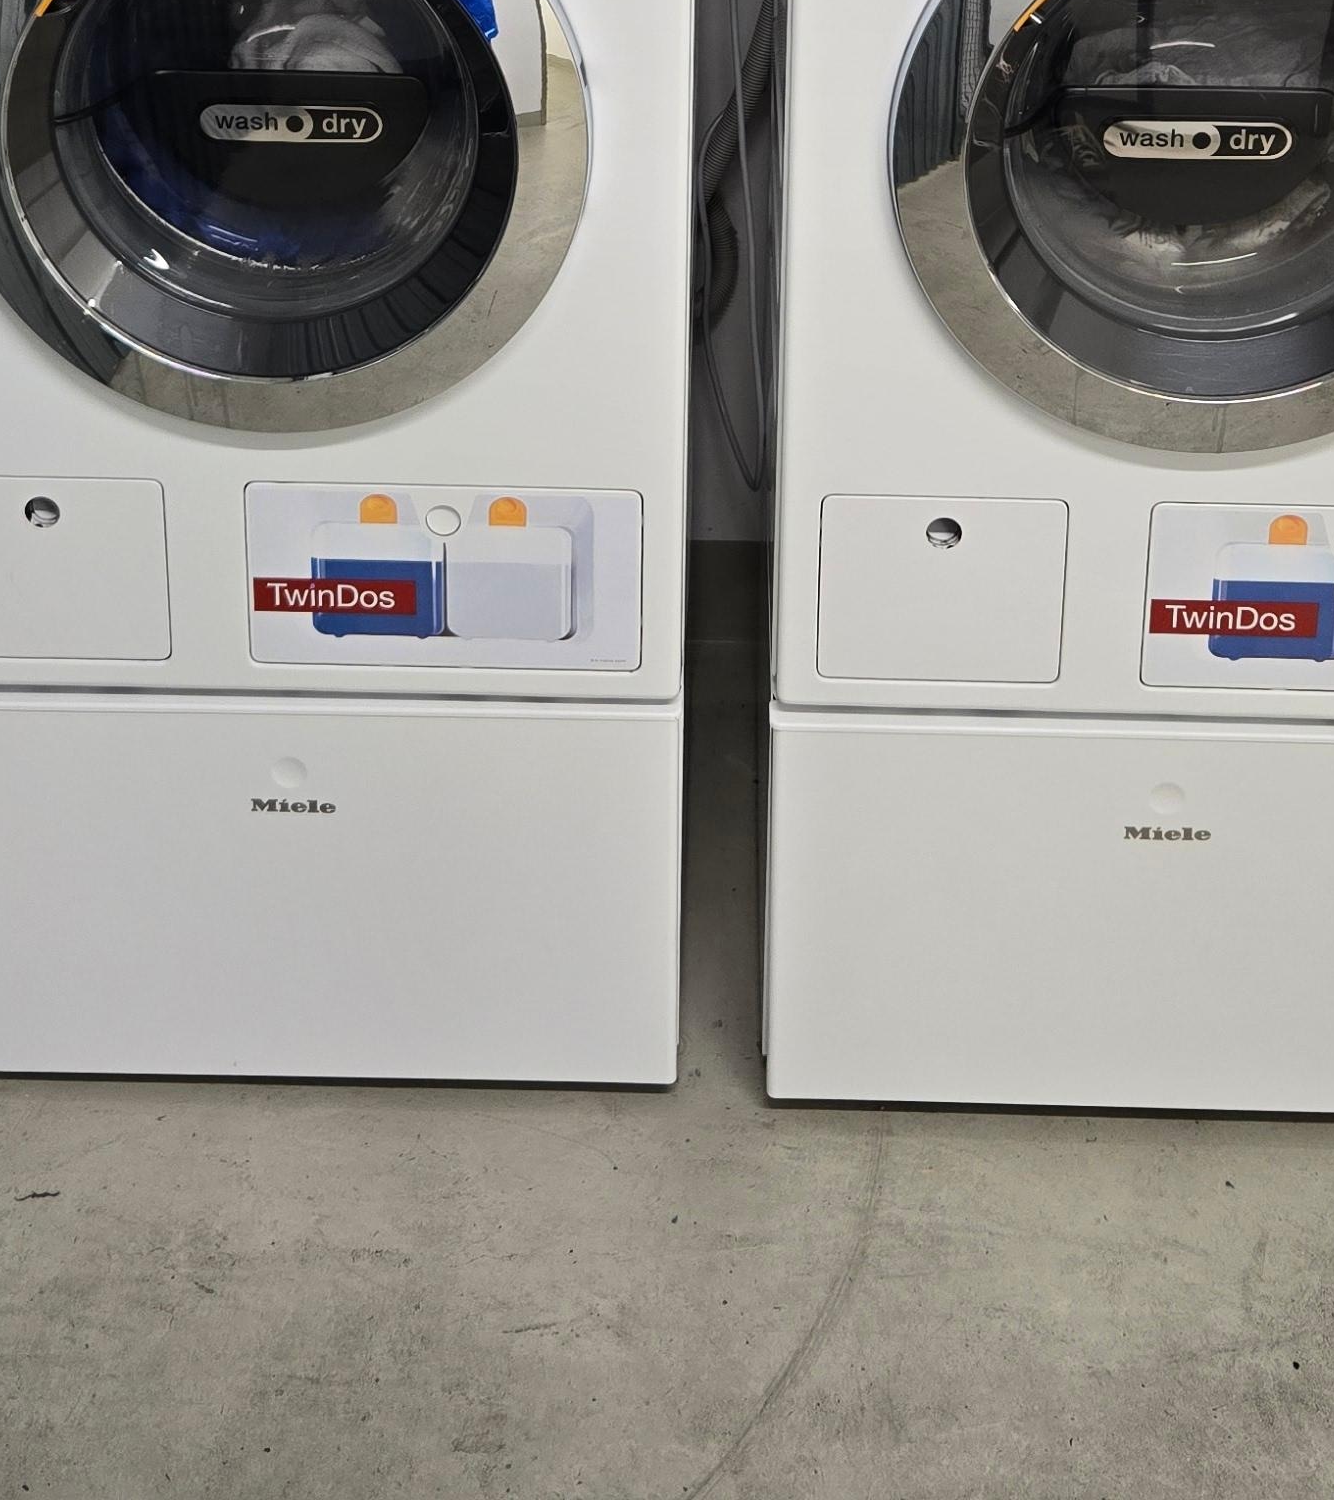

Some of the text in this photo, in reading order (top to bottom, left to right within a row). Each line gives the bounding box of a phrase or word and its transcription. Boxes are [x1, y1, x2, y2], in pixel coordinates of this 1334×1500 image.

[215, 113, 367, 138] wash dry
[1119, 129, 1276, 155] wash dry
[267, 582, 396, 609] TwinDos
[1165, 604, 1296, 632] TwinDos
[251, 798, 336, 815] Miele
[1123, 826, 1212, 842] Miele
